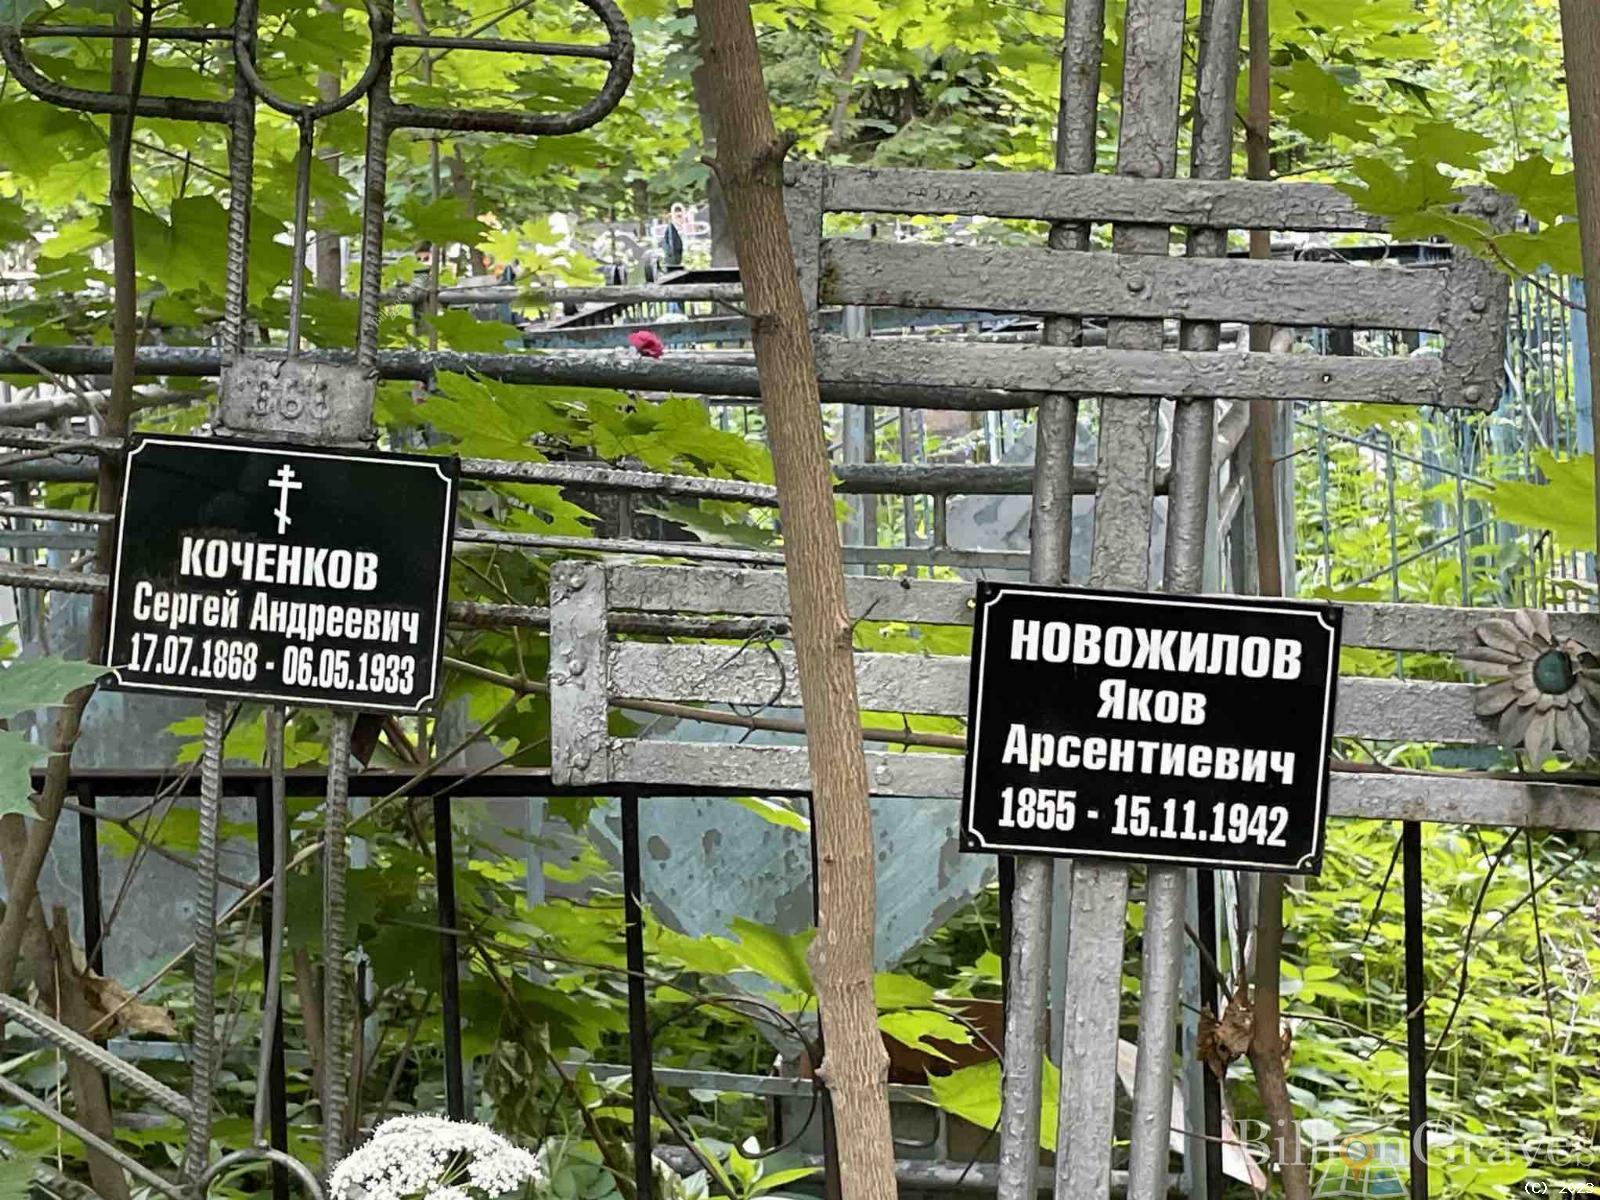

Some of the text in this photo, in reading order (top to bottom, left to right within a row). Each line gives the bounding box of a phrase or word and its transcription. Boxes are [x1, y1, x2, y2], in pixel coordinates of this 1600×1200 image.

[180, 536, 379, 591] КОЧЕНКОВ
[133, 581, 420, 643] Сергей Андреевич
[128, 632, 259, 682] 17.07.1868
[282, 645, 416, 695] 06.05.1933
[1010, 619, 1302, 680] НОВОЖИЛОВ
[1096, 678, 1207, 725] Яков
[1001, 723, 1295, 785] Арсентиевич
[998, 786, 1077, 831] 1855
[1111, 794, 1289, 847] 15.11.1942
